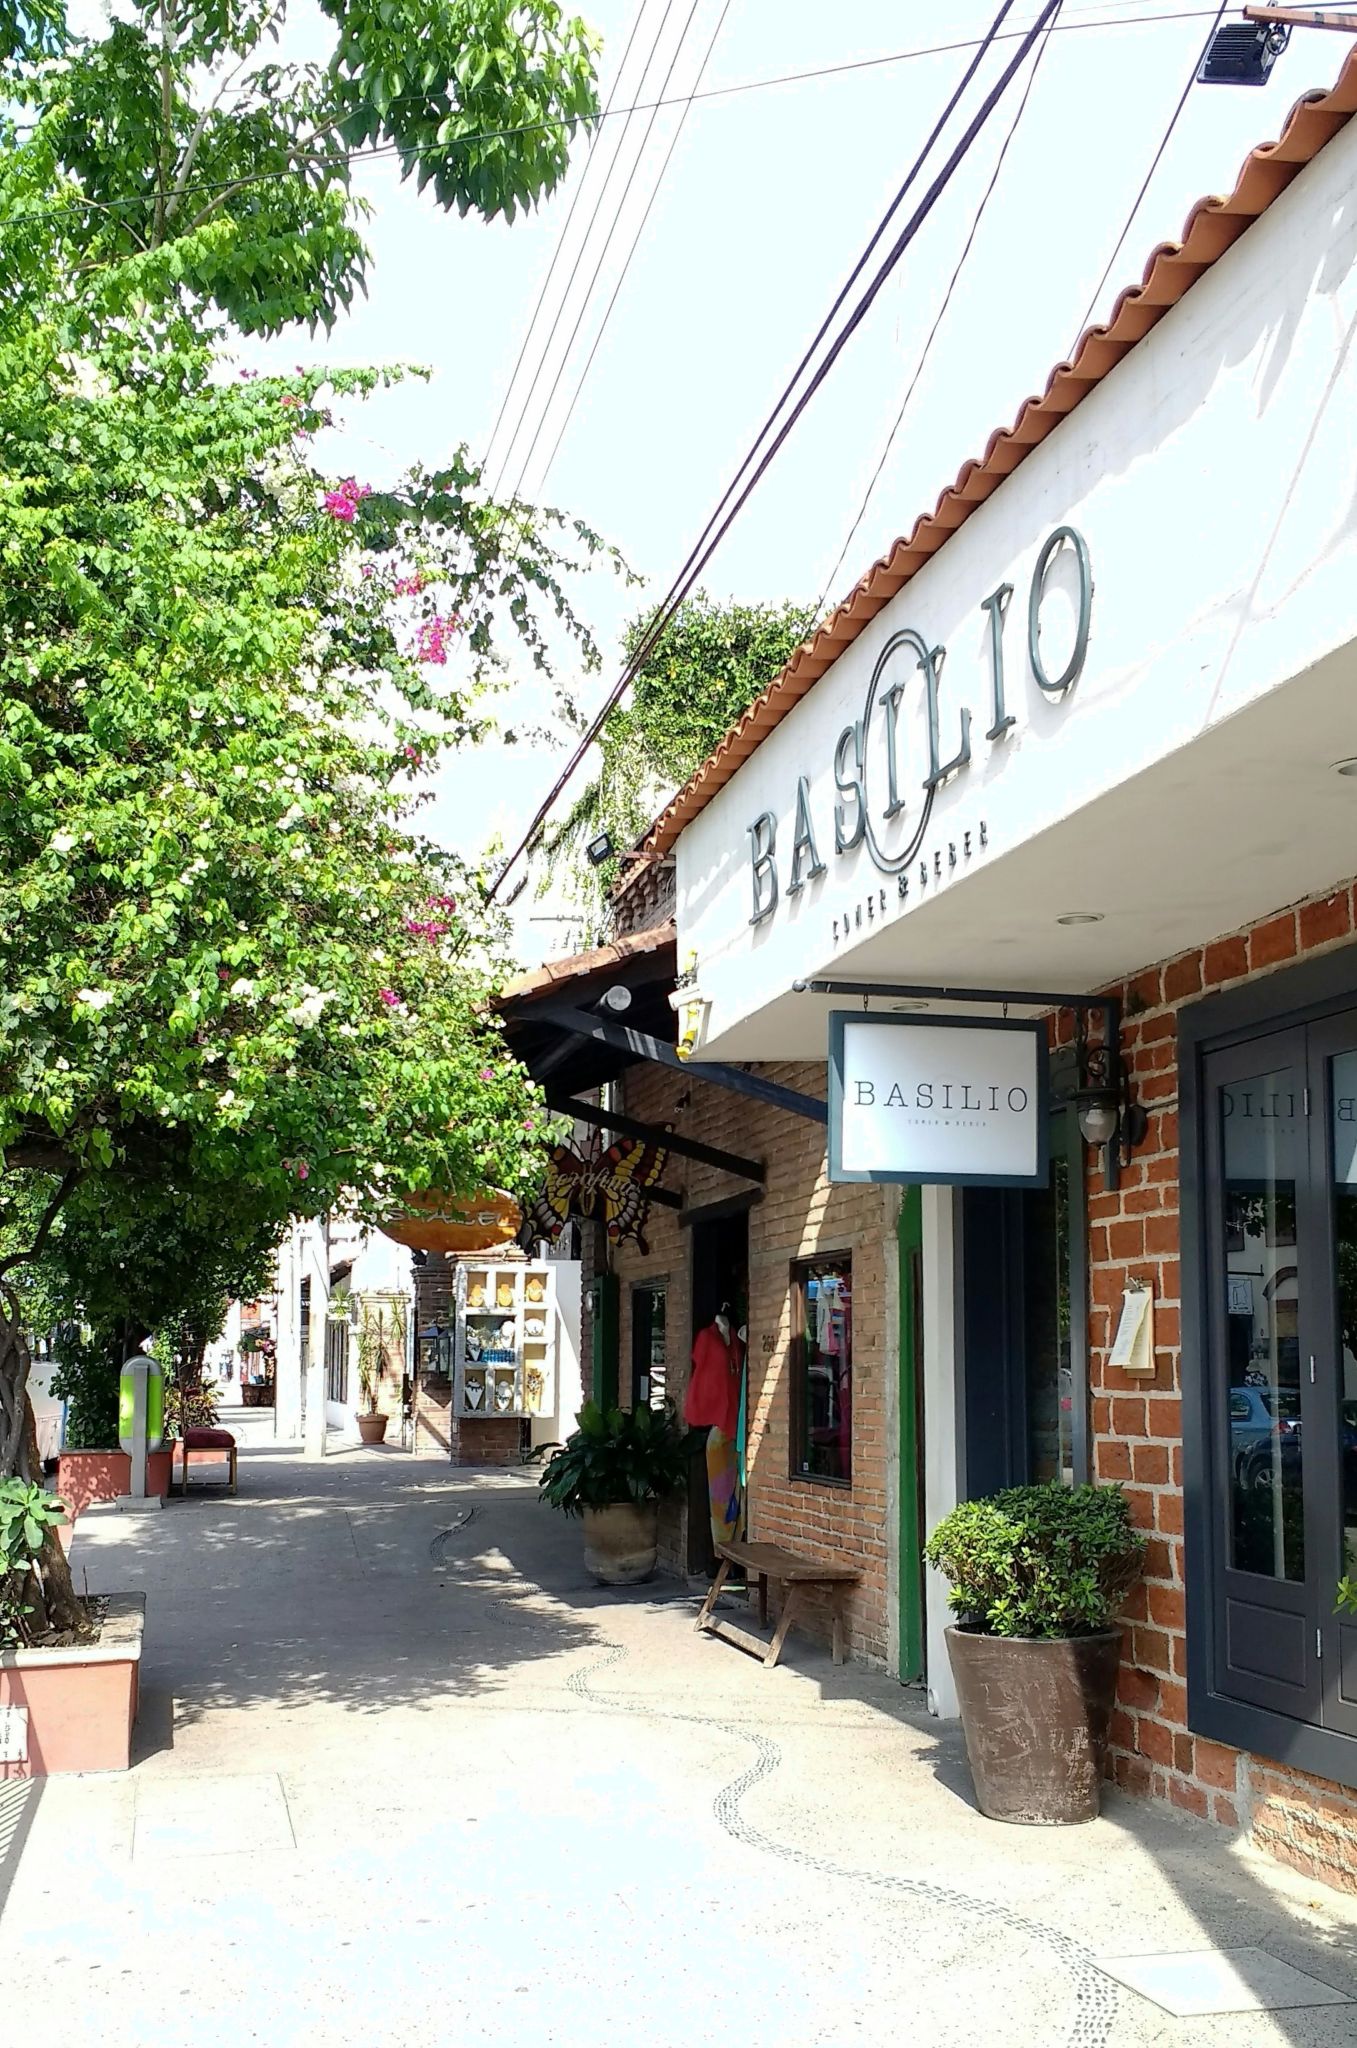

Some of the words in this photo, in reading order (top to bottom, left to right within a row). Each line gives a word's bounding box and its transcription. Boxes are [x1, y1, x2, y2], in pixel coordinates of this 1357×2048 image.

[746, 525, 1094, 926] BASILIO
[897, 874, 909, 898] &
[919, 820, 988, 885] BEBER
[853, 1080, 1028, 1113] BASILIO
